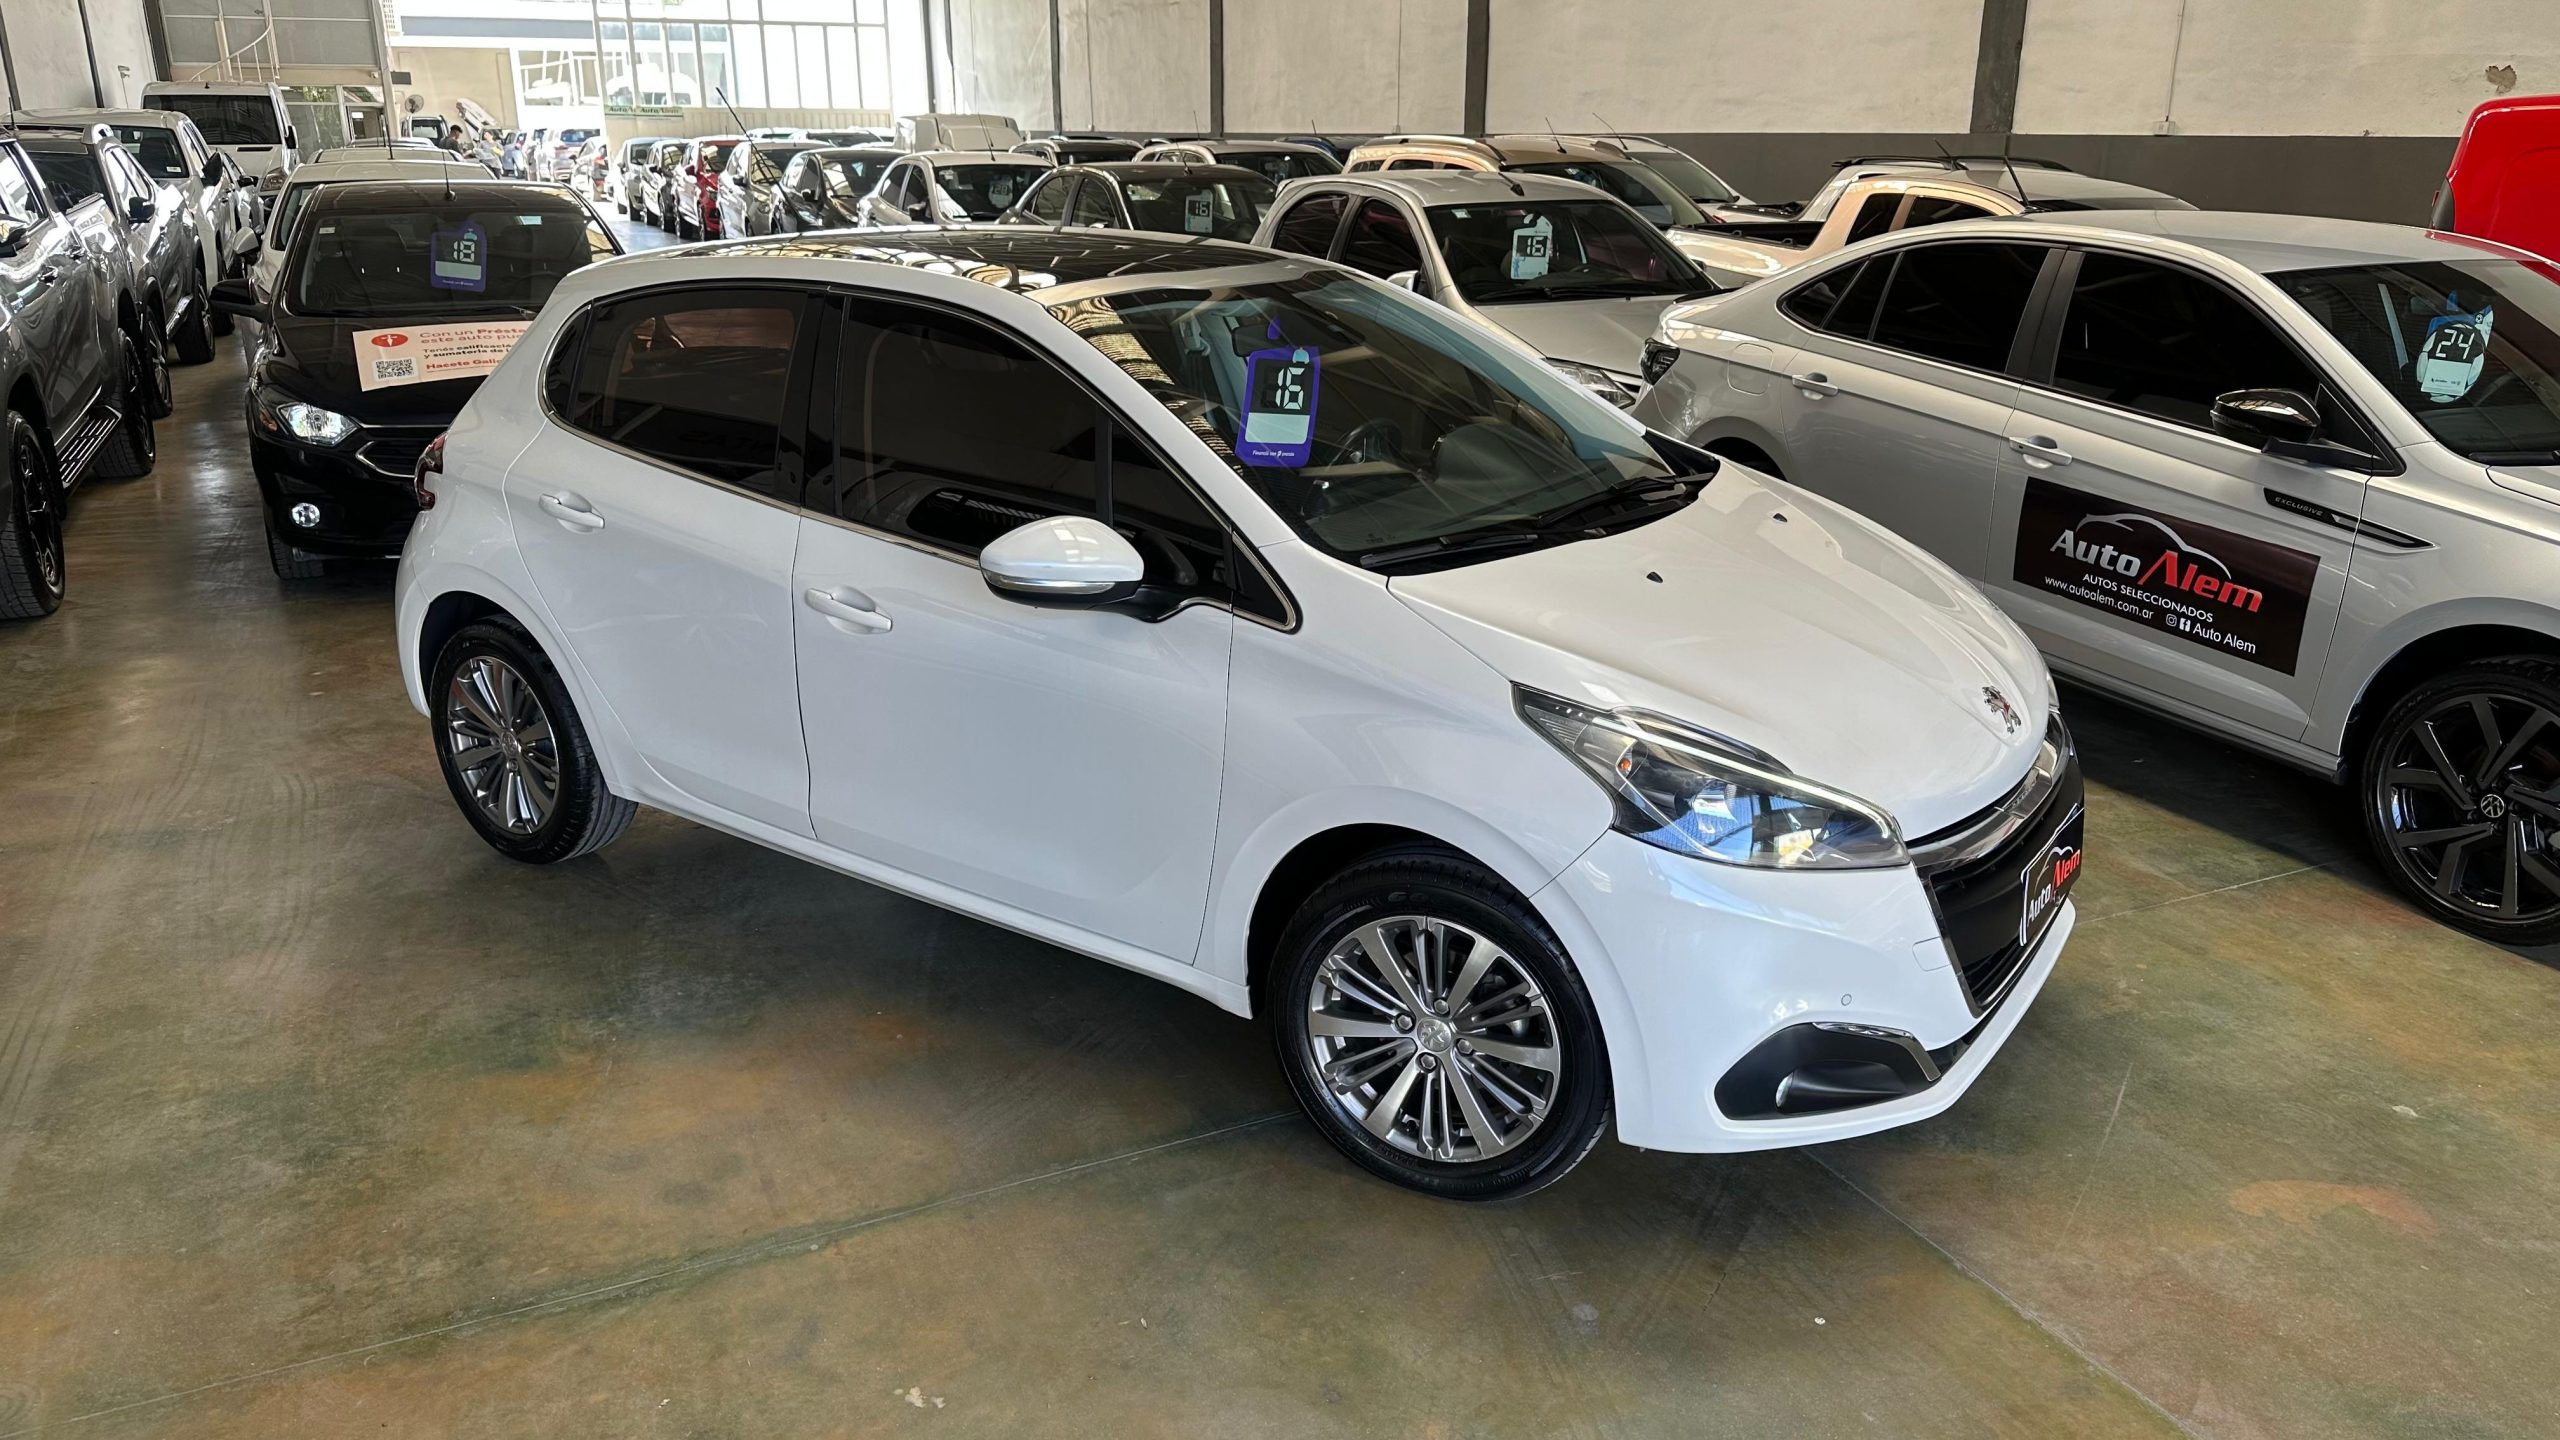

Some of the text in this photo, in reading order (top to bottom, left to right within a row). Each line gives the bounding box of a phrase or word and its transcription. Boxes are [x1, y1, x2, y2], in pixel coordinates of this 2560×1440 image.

[1195, 202, 1208, 216] 16
[453, 240, 475, 262] 18
[1526, 236, 1544, 257] 16
[419, 331, 451, 339] Con
[2435, 328, 2475, 360] 24
[433, 349, 487, 357] sumatoria
[426, 361, 470, 370] Hacete
[1275, 367, 1305, 410] 16
[2275, 497, 2323, 516] EXCLUSIVE
[2050, 529, 2263, 613] Auto Alem
[2082, 573, 2214, 623] AUTOS SELECCIONADOS
[2044, 576, 2256, 655] www.autoalem.com.ar Auto Alem
[2027, 849, 2081, 926] Auto Alem
